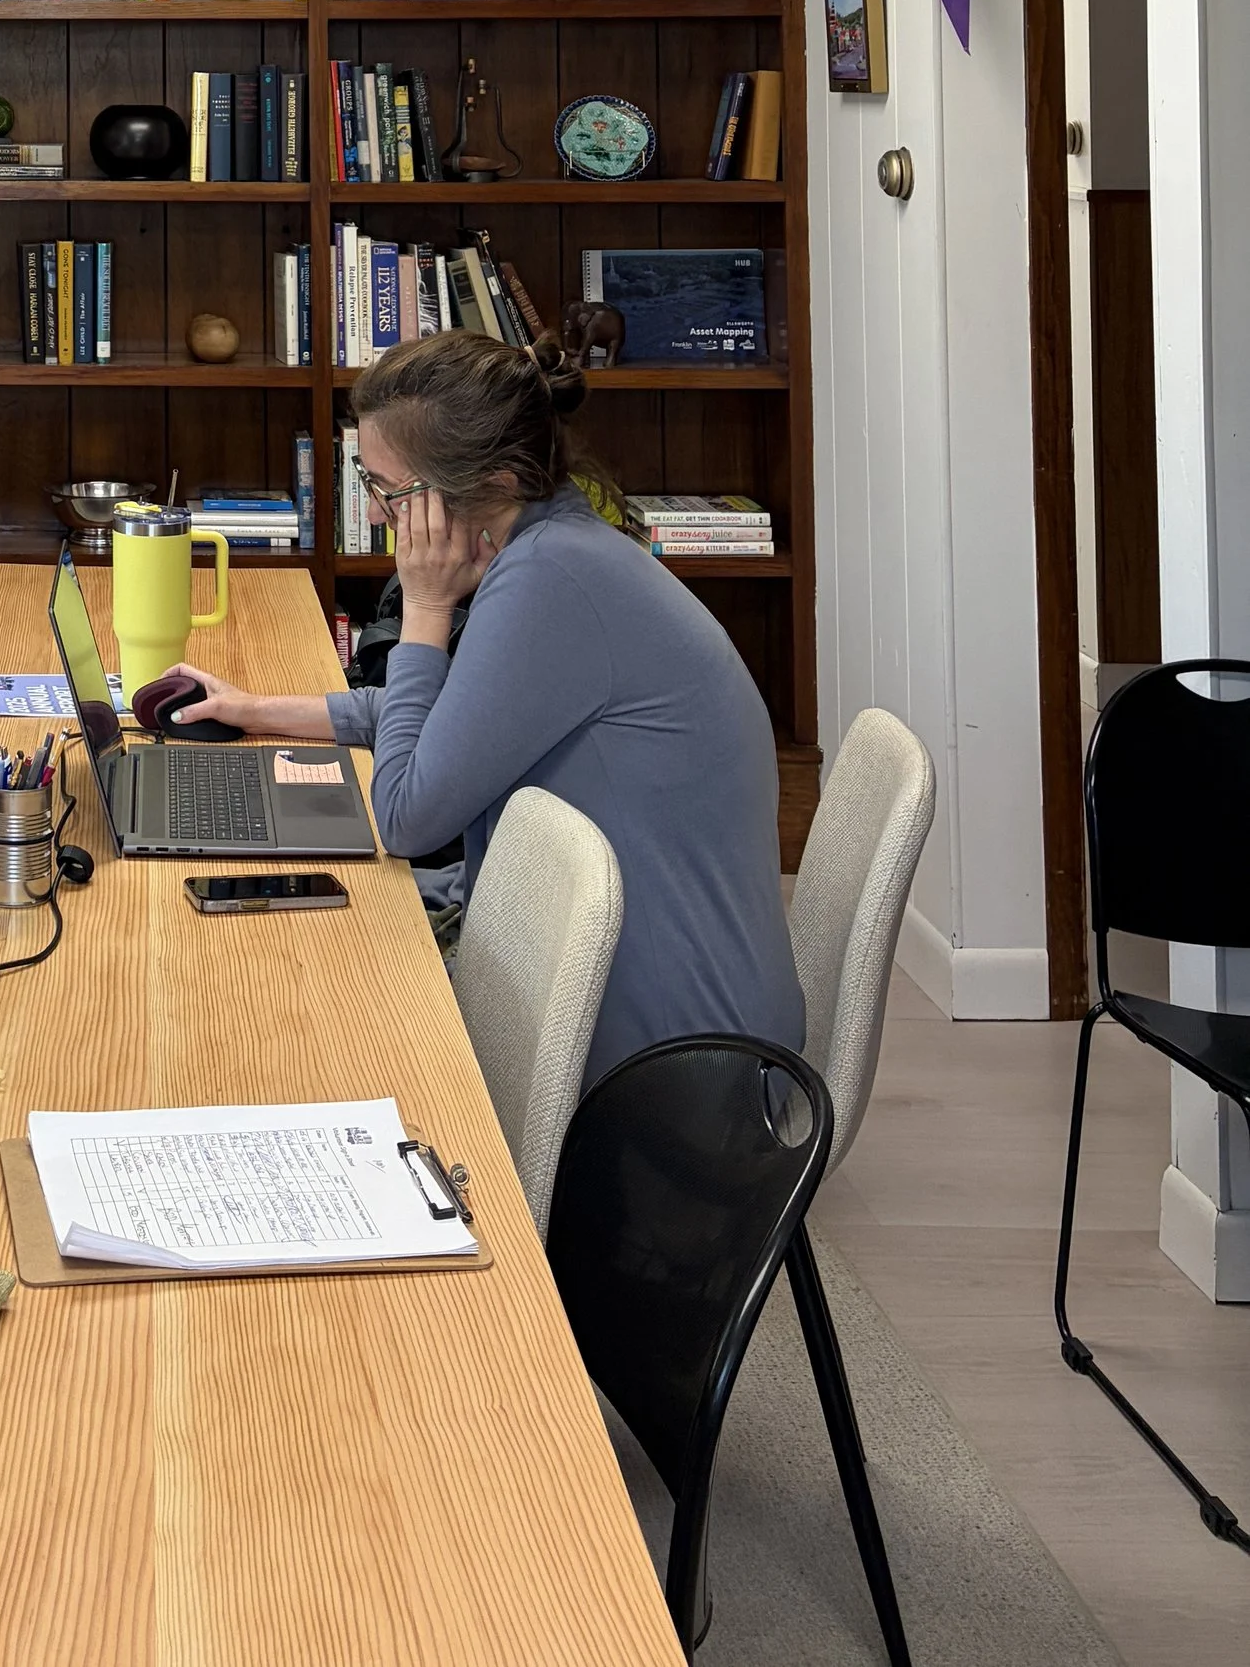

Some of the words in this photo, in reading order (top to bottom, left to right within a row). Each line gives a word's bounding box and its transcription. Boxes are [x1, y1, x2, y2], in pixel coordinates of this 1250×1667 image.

[288, 91, 296, 118] GEORGE
[345, 79, 353, 111] GROUPS
[380, 75, 392, 114] greenwich
[288, 119, 296, 154] ELIZABETH
[384, 117, 393, 134] park
[28, 252, 36, 266] STAY
[102, 254, 110, 266] THE
[29, 268, 37, 289] CLOSE
[347, 266, 356, 295] Relapse
[377, 267, 390, 283] 112
[30, 292, 38, 318] HARLAN
[349, 296, 357, 336] Prevention
[378, 286, 391, 332] YEARS
[30, 320, 39, 341] COBEN
[102, 314, 110, 331] DIET
[689, 327, 714, 335] Asset
[715, 327, 754, 337] Mapping
[711, 529, 732, 538] juice
[336, 620, 349, 639] JAMES
[336, 639, 349, 669] PATTERSON
[5, 696, 31, 713] 2025
[26, 684, 55, 714] ANNUAL
[52, 685, 77, 713] REPORT
